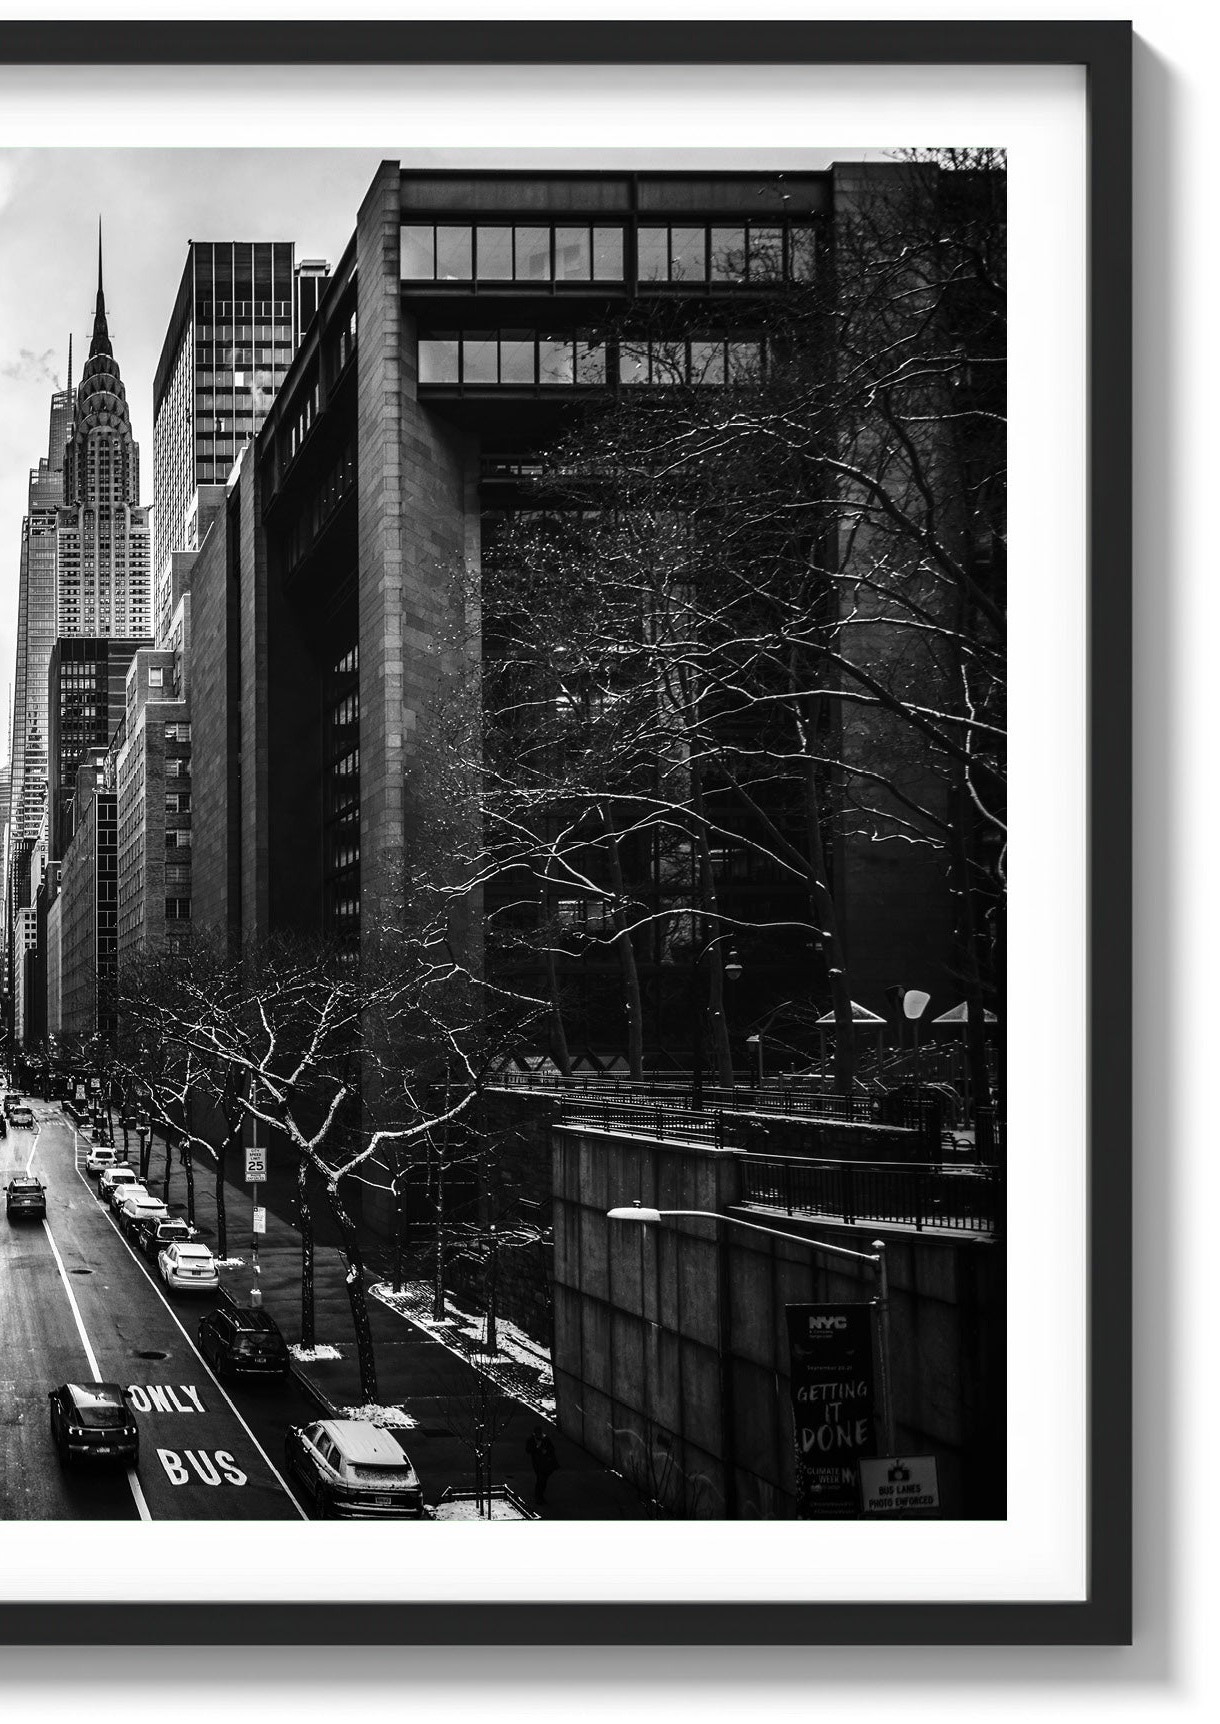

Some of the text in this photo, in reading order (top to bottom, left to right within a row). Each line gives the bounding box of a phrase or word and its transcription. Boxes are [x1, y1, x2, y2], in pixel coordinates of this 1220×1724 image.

[248, 1161, 264, 1171] 25
[809, 1316, 847, 1329] NYC
[797, 1380, 867, 1401] GETTING
[127, 1385, 205, 1412] ONLY
[825, 1402, 843, 1422] IT
[801, 1417, 868, 1452] DONE
[156, 1448, 248, 1486] BUS
[806, 1467, 840, 1475] CLIMATE
[818, 1475, 840, 1484] WEEK
[878, 1484, 921, 1495] BUS LANES
[868, 1495, 934, 1508] PHOTO ENFORCED
